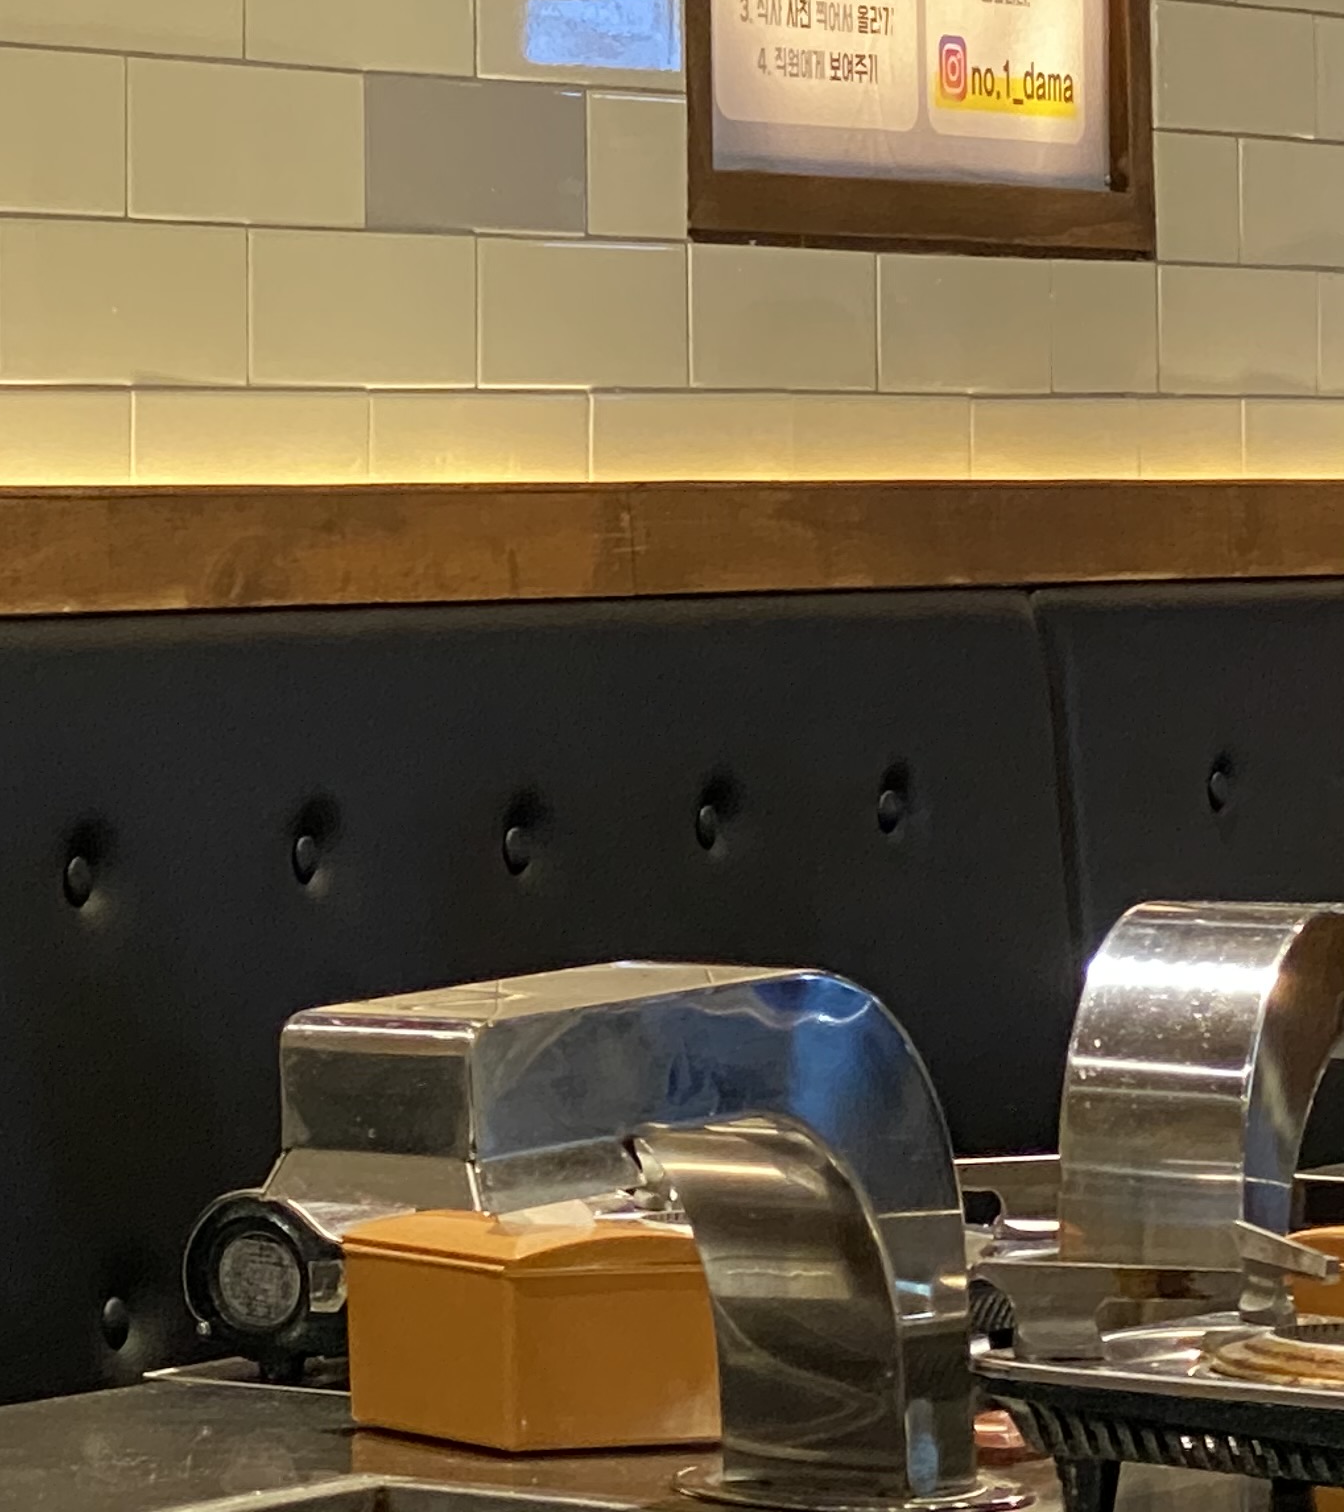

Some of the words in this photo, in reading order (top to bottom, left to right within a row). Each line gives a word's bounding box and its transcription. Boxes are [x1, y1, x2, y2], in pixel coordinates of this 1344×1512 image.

[816, 0, 854, 32] 찍어서
[775, 46, 826, 79] 직원에게
[829, 51, 879, 84] 보여주기
